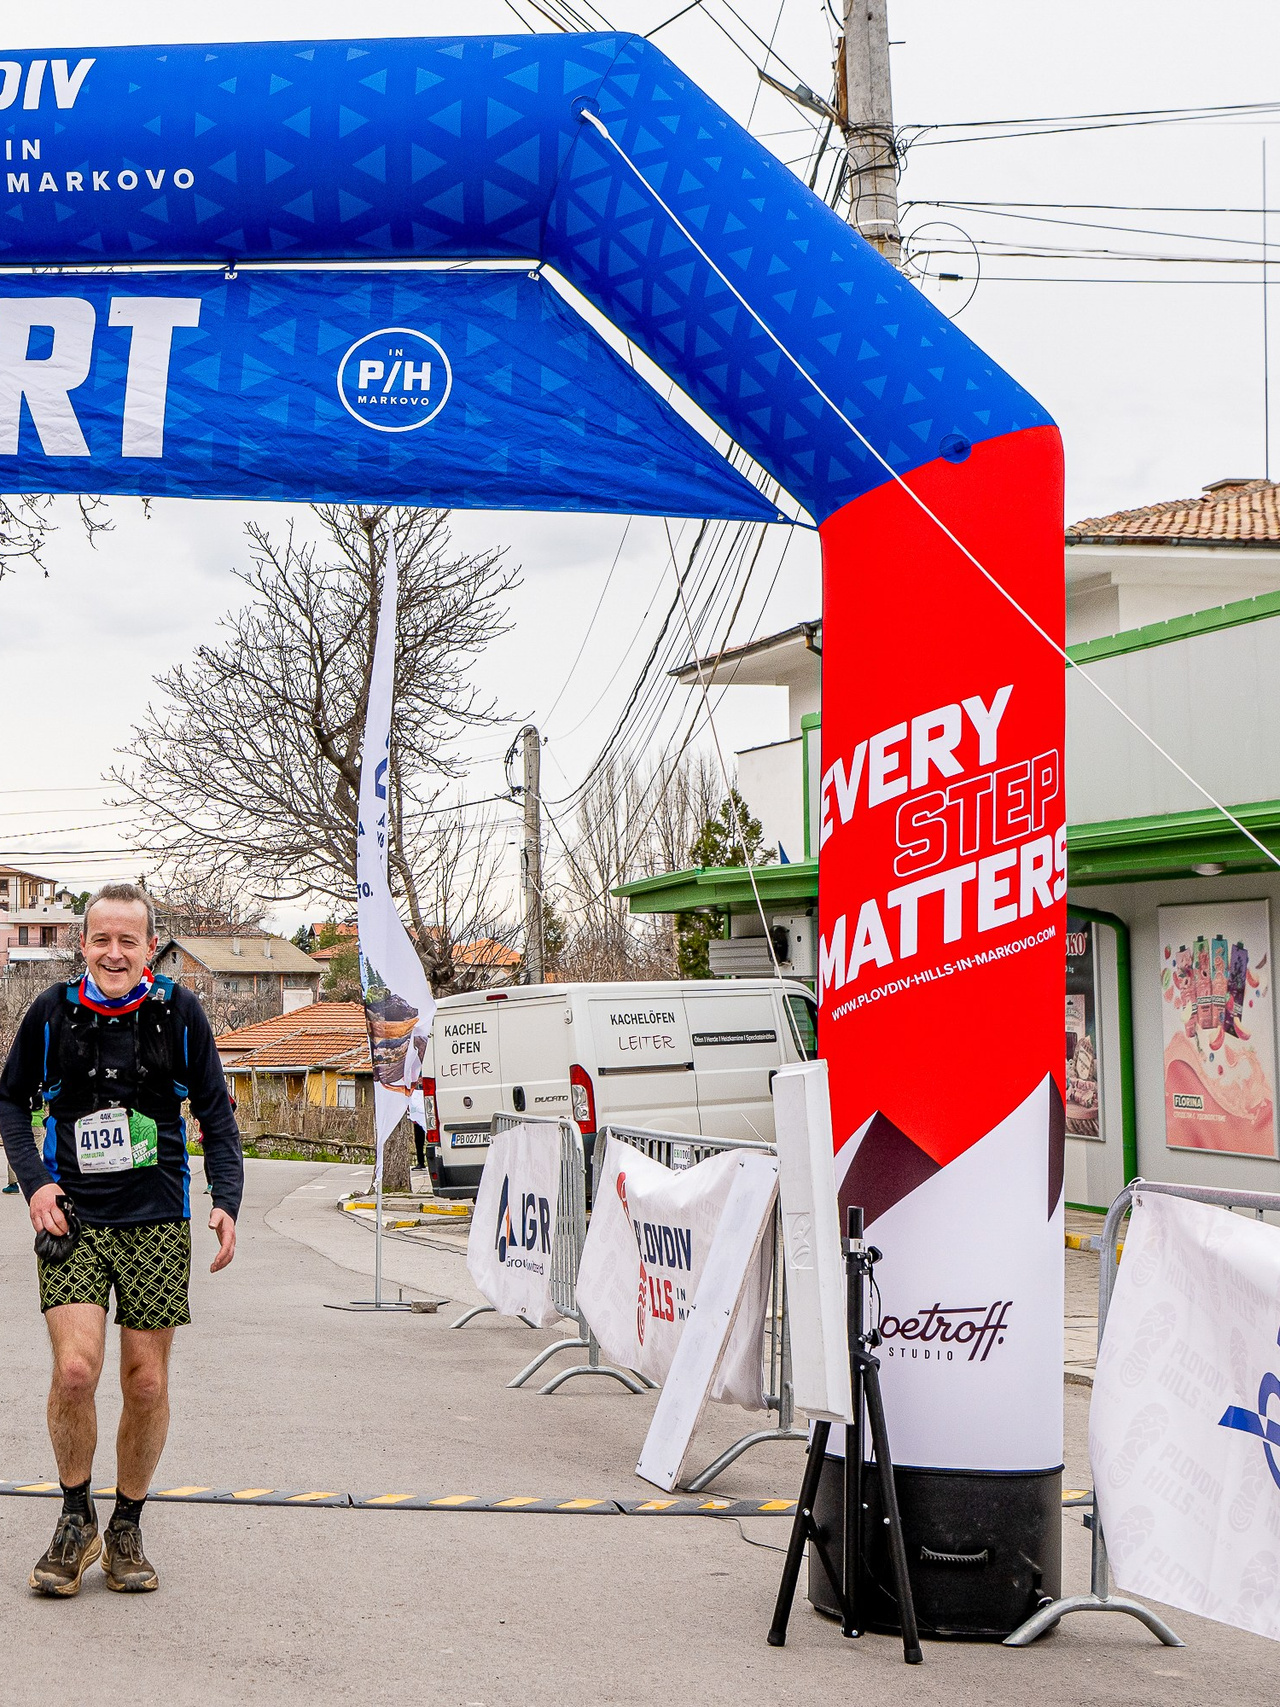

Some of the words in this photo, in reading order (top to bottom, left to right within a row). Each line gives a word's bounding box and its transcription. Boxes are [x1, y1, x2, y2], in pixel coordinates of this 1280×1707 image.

[6, 139, 40, 160] IN
[7, 169, 195, 193] MARKOVO
[358, 360, 431, 393] P/H
[358, 396, 429, 405] MARKOVO
[820, 684, 1014, 851] EVERY
[893, 748, 1059, 877] STEP
[818, 822, 1067, 1009] MATTERS
[831, 925, 1056, 1021] WWW.PLOVDIV-HILLS-IN-MARKOVO.COM
[610, 1010, 675, 1025] KACHELÖFEN
[444, 1022, 487, 1037] KACHEL
[451, 1040, 480, 1054] ÖFEN
[618, 1035, 675, 1050] LEITER
[441, 1062, 493, 1077] LEITER
[534, 1095, 568, 1103] DUCATO
[81, 1127, 125, 1150] 4134
[677, 1288, 686, 1301] IN
[889, 1347, 953, 1360] STUDIO
[1157, 1442, 1223, 1507] PLOVDIV
[1142, 1466, 1195, 1516] HILLS
